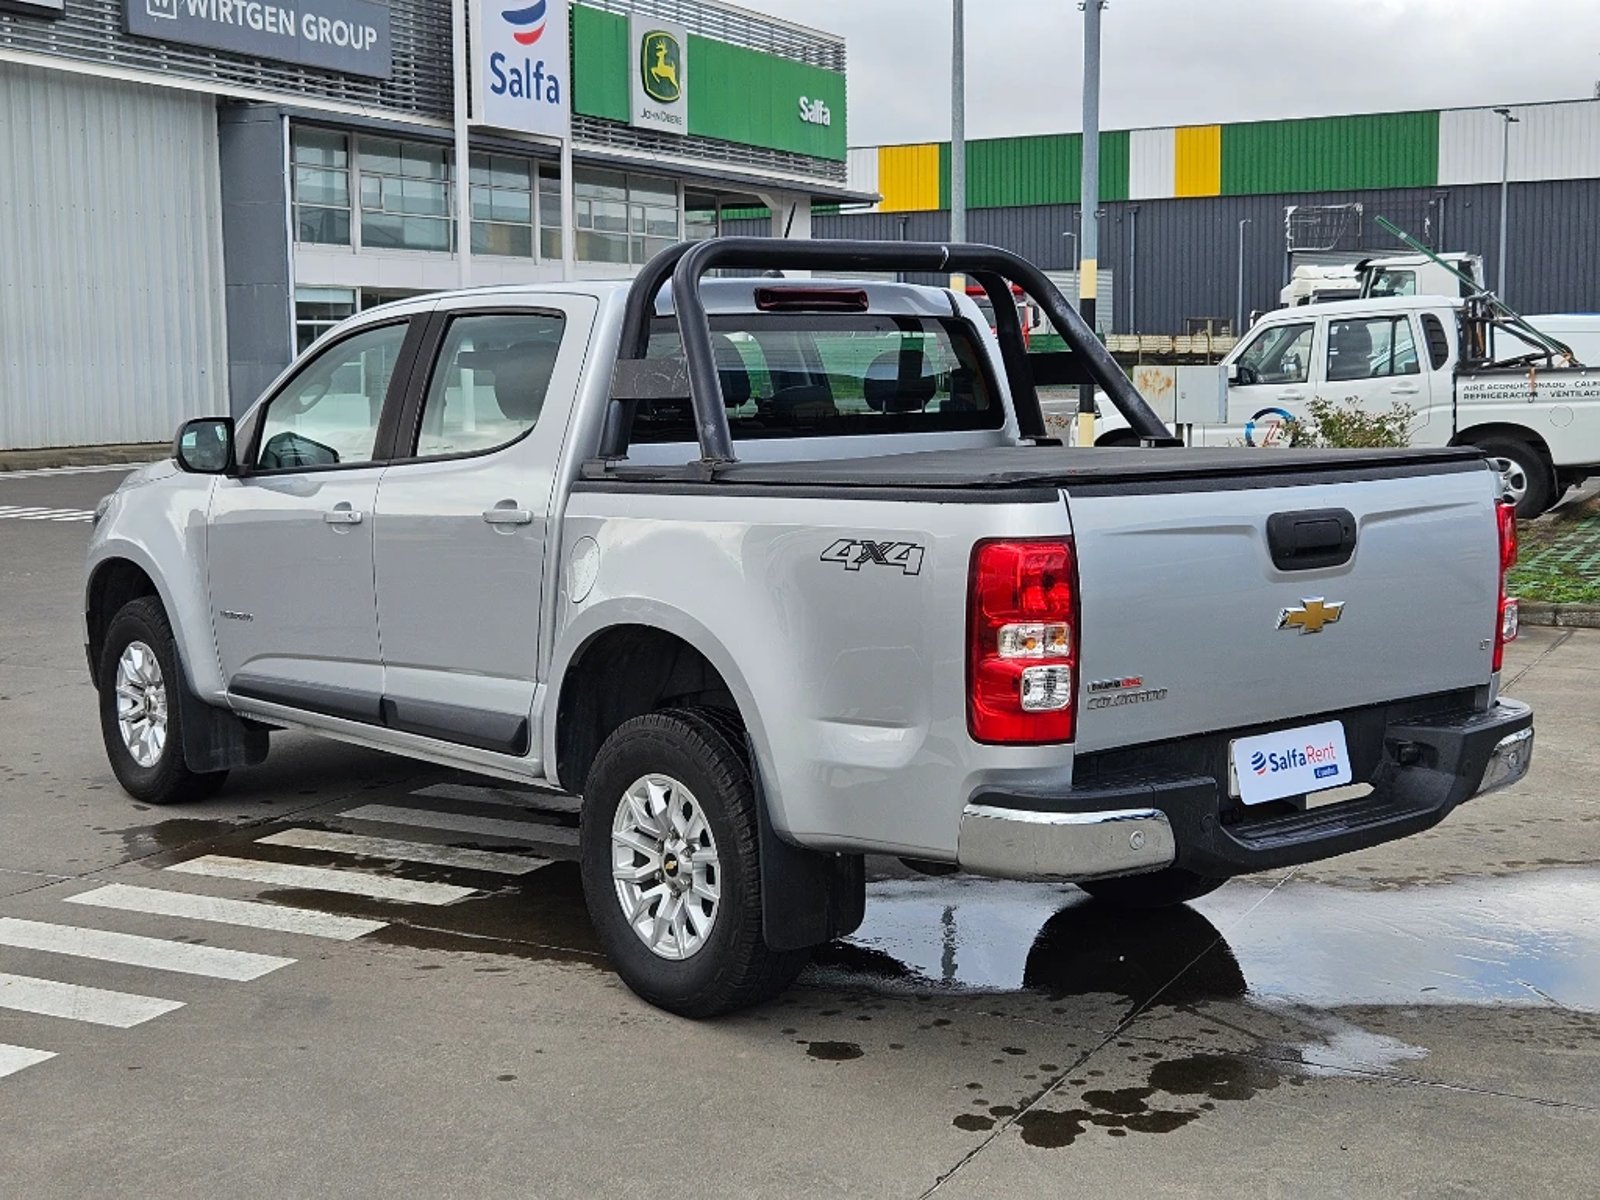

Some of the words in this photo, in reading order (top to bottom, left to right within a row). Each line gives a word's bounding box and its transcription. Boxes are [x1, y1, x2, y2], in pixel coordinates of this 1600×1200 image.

[187, 0, 296, 36] WIRTGEN
[302, 13, 377, 50] GROUP
[490, 51, 560, 104] Salfa
[800, 96, 831, 126] Salfa
[1463, 383, 1485, 392] AIRE
